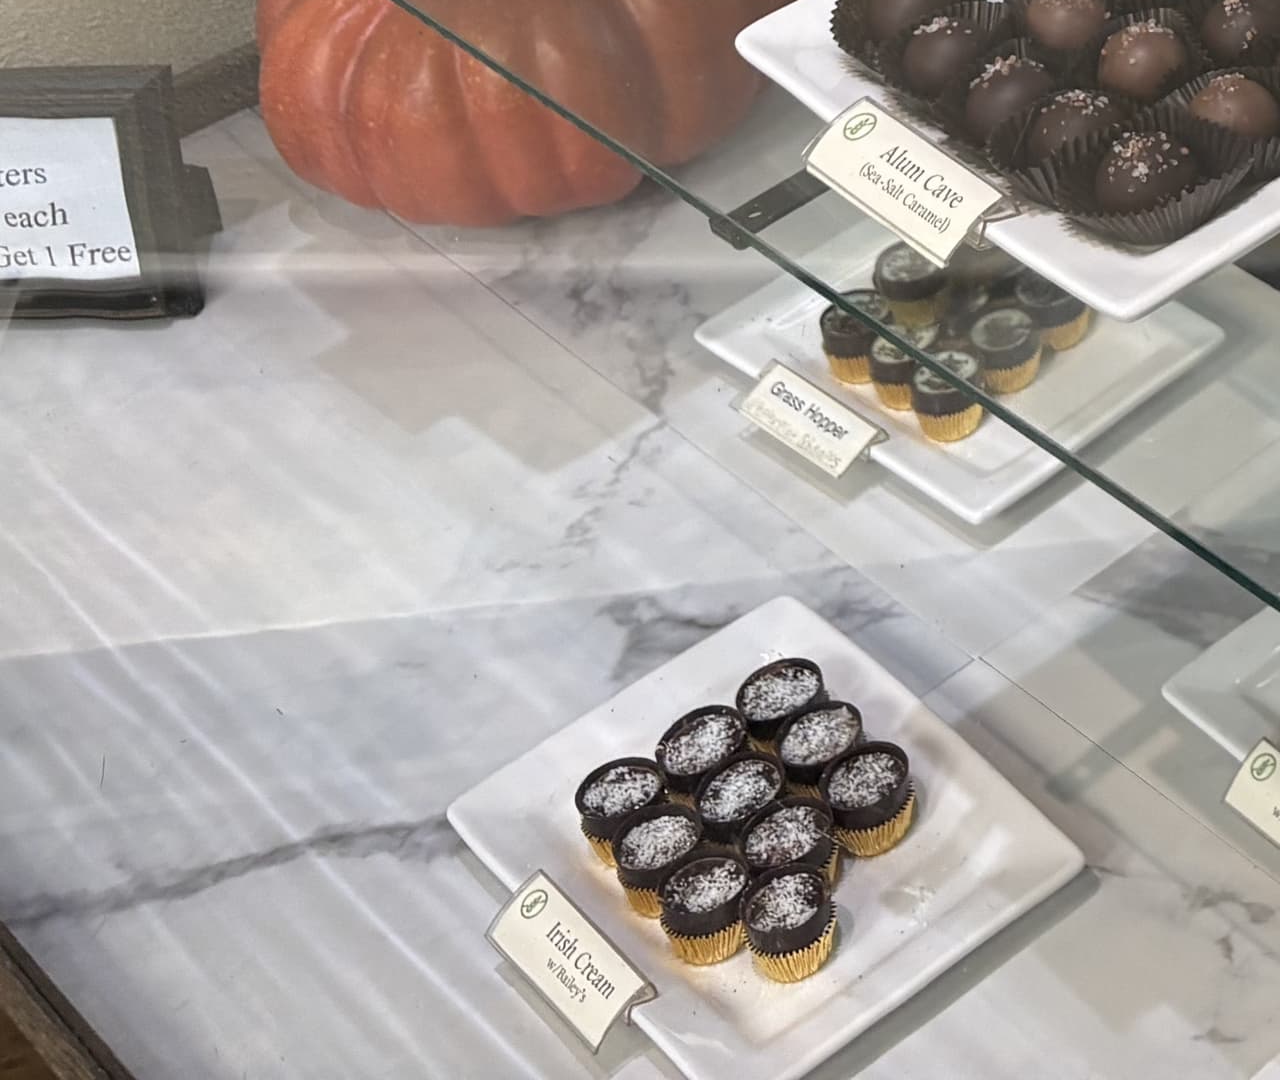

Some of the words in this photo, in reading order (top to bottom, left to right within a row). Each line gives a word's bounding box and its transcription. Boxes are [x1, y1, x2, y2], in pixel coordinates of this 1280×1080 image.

[859, 162, 905, 201] (Sea-Salt
[902, 192, 952, 235] Caramel)
[880, 145, 926, 183] Alum
[923, 173, 965, 209] Cave
[3, 201, 70, 229] each
[67, 242, 132, 268] Free
[770, 381, 806, 412] Grass
[803, 403, 849, 440] Hopper
[545, 921, 579, 960] Irish
[573, 952, 616, 1000] Cream
